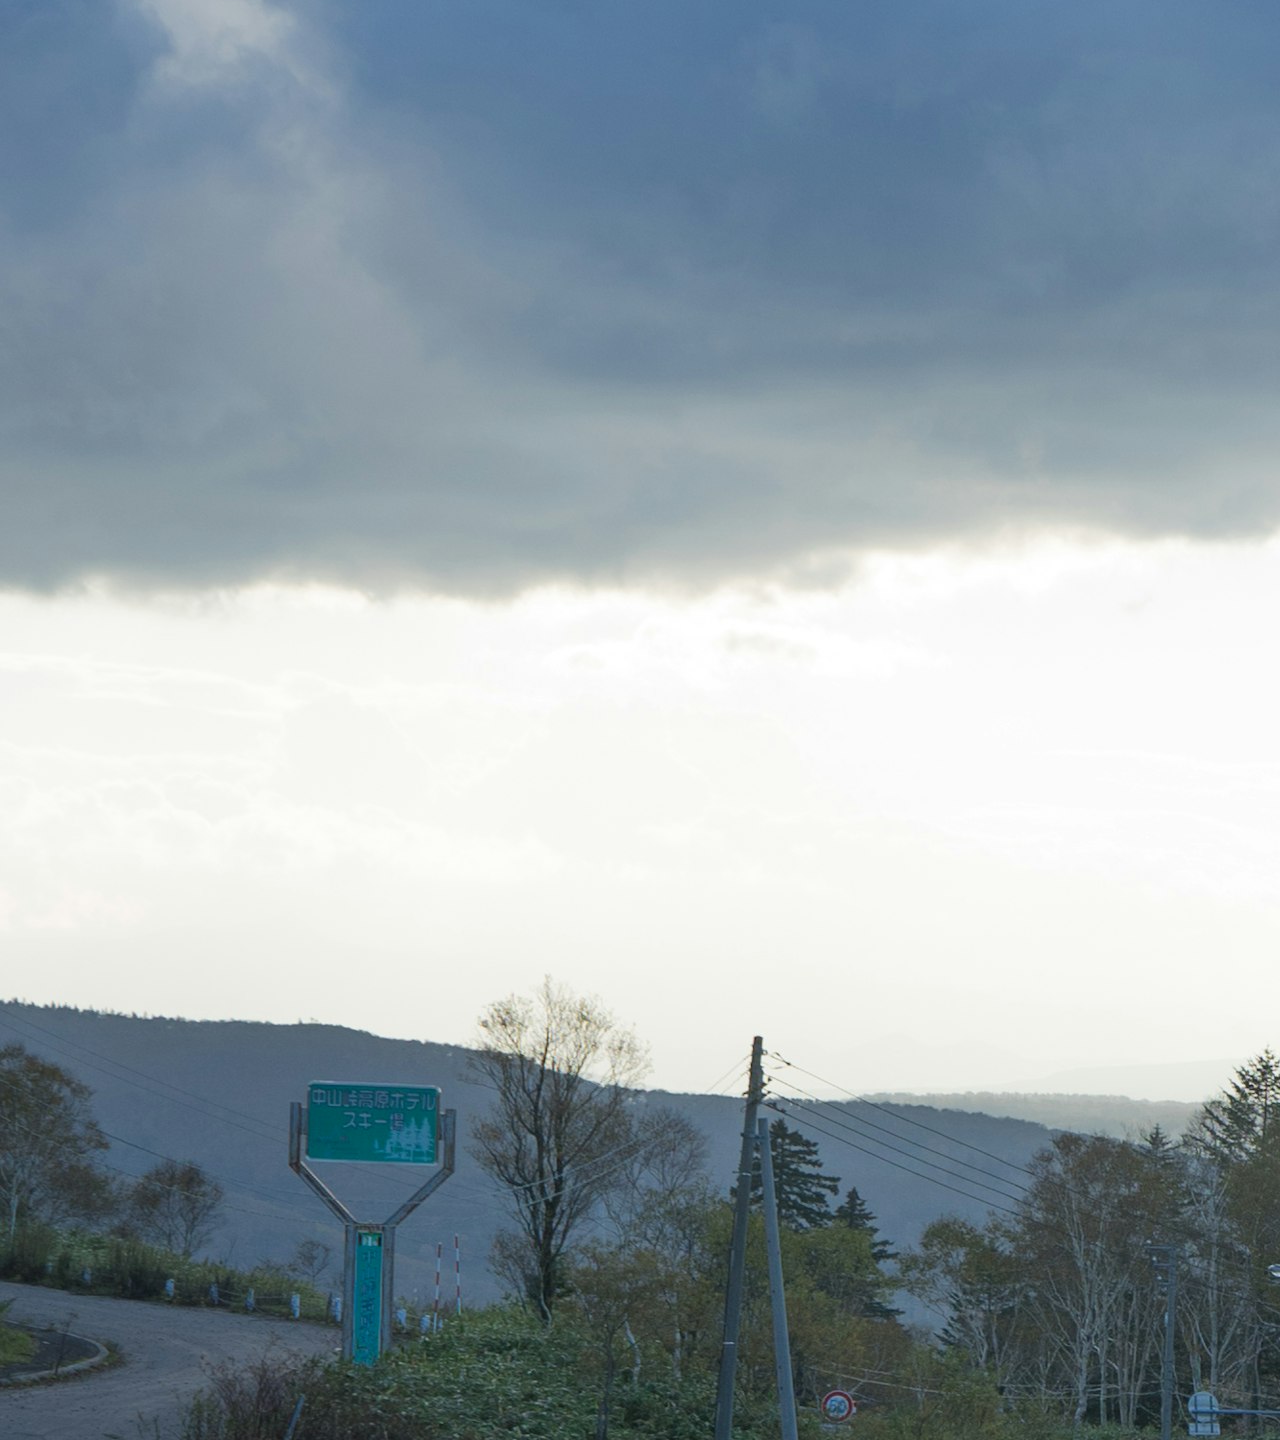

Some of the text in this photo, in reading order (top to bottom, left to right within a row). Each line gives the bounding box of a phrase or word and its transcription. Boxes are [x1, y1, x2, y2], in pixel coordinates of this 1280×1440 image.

[312, 1088, 436, 1110] 中山峠高原ホテル
[343, 1111, 405, 1133] スキー場
